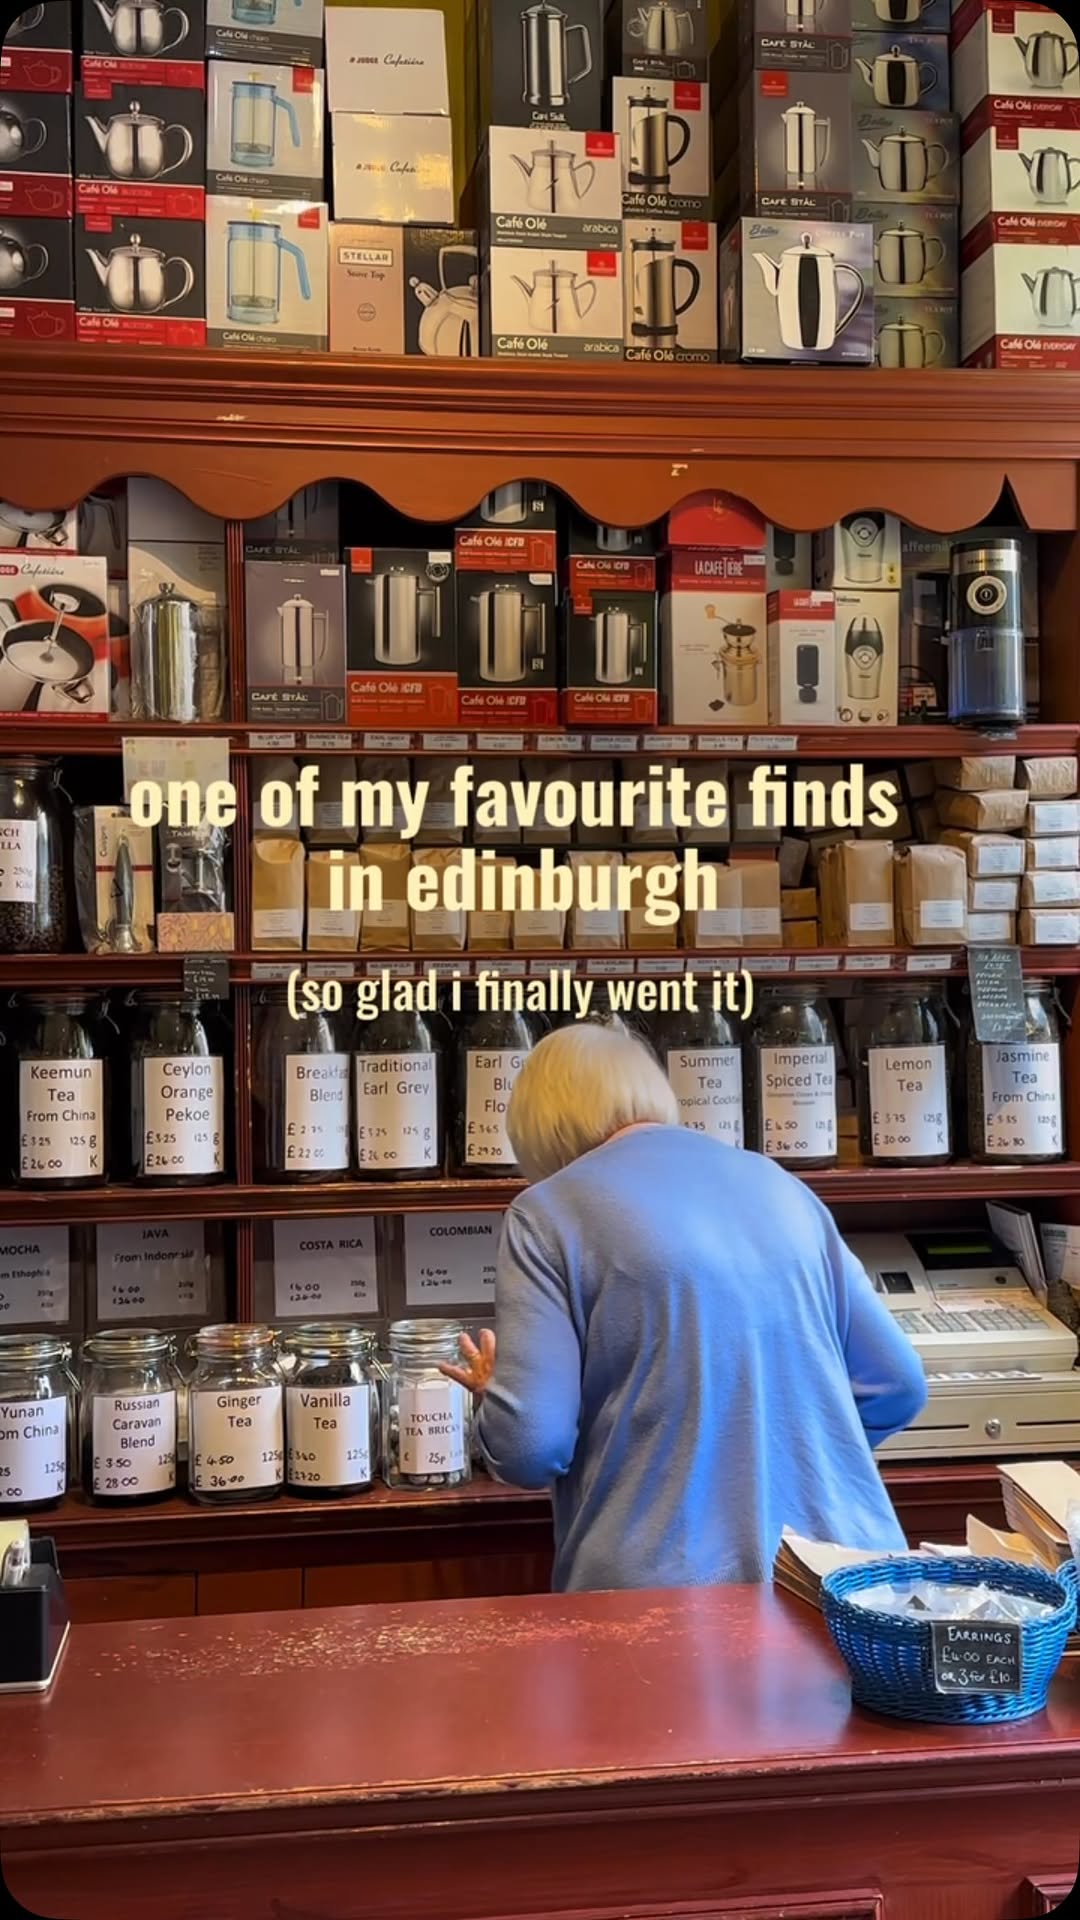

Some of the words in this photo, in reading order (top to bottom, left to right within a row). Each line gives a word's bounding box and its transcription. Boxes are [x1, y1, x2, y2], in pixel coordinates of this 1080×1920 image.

[647, 195, 668, 207] Olé
[761, 197, 788, 206] CAFÉ
[496, 216, 524, 229] Café
[525, 217, 548, 230] Olé
[582, 224, 618, 234] arabica
[344, 252, 388, 261] STELLAR
[497, 337, 524, 350] Café
[526, 338, 548, 351] Olé
[584, 343, 620, 353] arabica
[1000, 339, 1022, 350] Café
[1024, 339, 1042, 350] Olé
[626, 349, 652, 361] Café
[653, 349, 674, 362] Olé
[676, 353, 710, 362] cromo
[459, 535, 483, 546] Café
[484, 536, 502, 547] Olé
[351, 681, 377, 692] Café
[379, 682, 398, 693] Olé
[475, 1056, 502, 1069] Earl
[680, 1055, 735, 1068] Summer
[774, 1052, 827, 1066] Imperial
[996, 1050, 1050, 1064] Jasmine
[163, 1062, 212, 1078] Ceylon
[360, 1058, 432, 1074] Traditional
[886, 1058, 932, 1071] Lemon
[30, 1066, 92, 1080] Keemun
[1012, 1071, 1038, 1084] Tea
[697, 1077, 722, 1089] Tea
[767, 1074, 812, 1088] Spiced
[815, 1073, 832, 1086] Tea
[897, 1079, 923, 1092] Tea
[48, 1088, 76, 1102] Tea
[161, 1085, 214, 1100] Orange
[310, 1089, 344, 1102] Blend
[363, 1082, 388, 1096] Earl
[397, 1081, 430, 1098] Grey
[992, 1092, 1023, 1102] From
[1027, 1091, 1056, 1102] China
[27, 1111, 58, 1122] From
[62, 1110, 96, 1122] China
[166, 1108, 210, 1122] Pekoe
[142, 1229, 169, 1240] JAVA
[430, 1226, 492, 1237] COLOMBIAN
[300, 1241, 334, 1251] COSTA
[338, 1239, 364, 1249] RICA
[115, 1399, 160, 1412] Russian
[217, 1395, 262, 1409] Ginger
[300, 1393, 351, 1408] Vanilla
[1, 1407, 44, 1420] Yunan
[411, 1413, 454, 1424] TOUCHA
[113, 1417, 162, 1431] Caravan
[227, 1416, 252, 1428] Tea
[313, 1417, 338, 1430] Tea
[24, 1424, 60, 1440] China
[406, 1427, 424, 1436] TEA
[121, 1435, 156, 1450] Blend
[429, 1452, 446, 1464] 25p
[275, 1468, 282, 1480] K
[360, 1468, 368, 1479] K
[57, 1480, 64, 1491] K
[947, 1626, 1012, 1645] EARRINGS
[942, 1645, 980, 1664] £4.00
[986, 1654, 1016, 1665] EACH
[958, 1668, 969, 1686] 3
